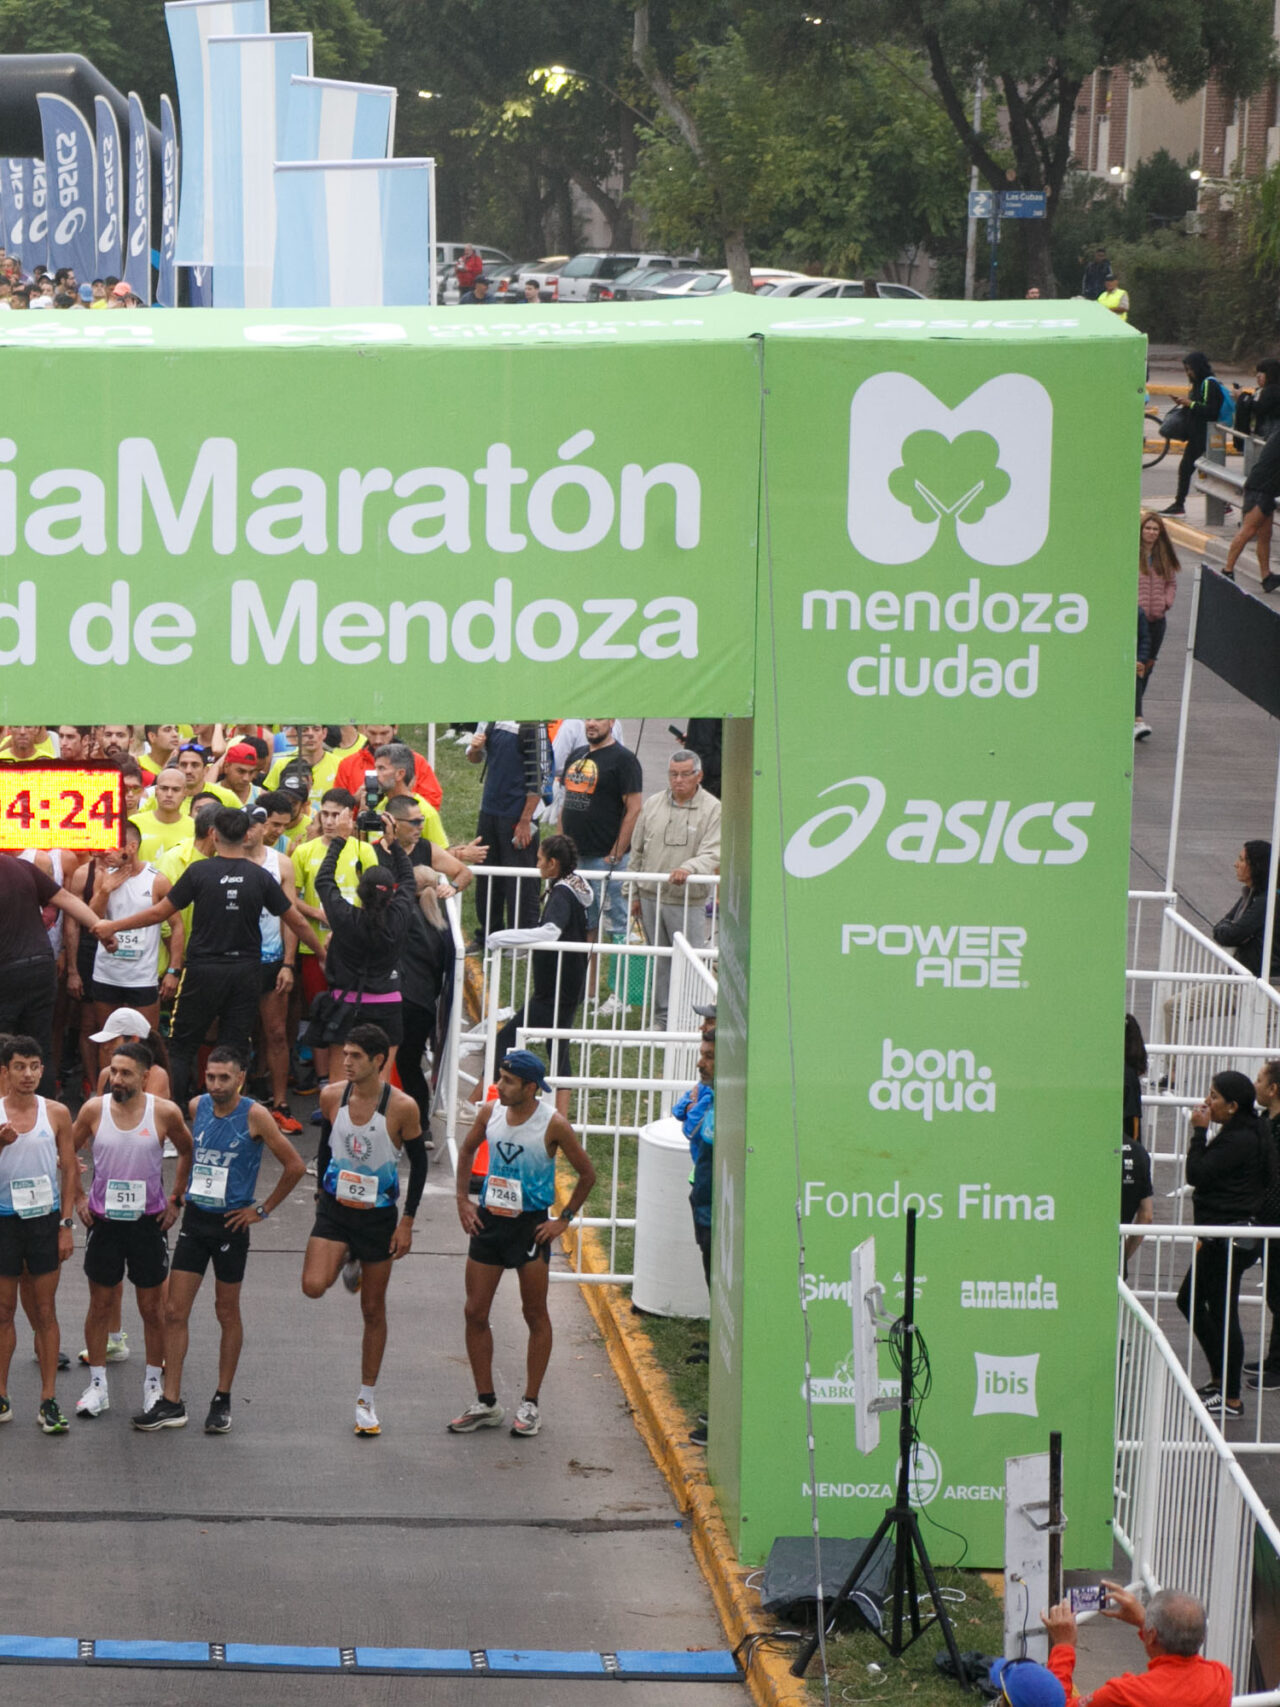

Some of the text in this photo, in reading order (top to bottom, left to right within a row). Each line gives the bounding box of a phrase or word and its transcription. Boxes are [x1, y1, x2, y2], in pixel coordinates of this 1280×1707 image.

[873, 318, 1081, 329] asics
[67, 579, 197, 667] de
[229, 575, 700, 666] Mendoza
[801, 577, 1090, 634] mendoza
[846, 643, 1040, 699] ciudad
[886, 799, 1097, 865] asics
[841, 923, 1028, 958] POWER
[915, 956, 1022, 989] ADE
[867, 1078, 997, 1122] aqua
[194, 1147, 240, 1167] GRT
[29, 1189, 36, 1200] 1
[116, 1191, 136, 1203] 511
[348, 1184, 366, 1197] 62
[491, 1187, 518, 1202] 1248
[803, 1180, 1056, 1222] Fondos Fima
[960, 1274, 1059, 1310] amanda
[984, 1371, 1029, 1396] ibis
[801, 1482, 1006, 1501] MENDOZA ARGEN
